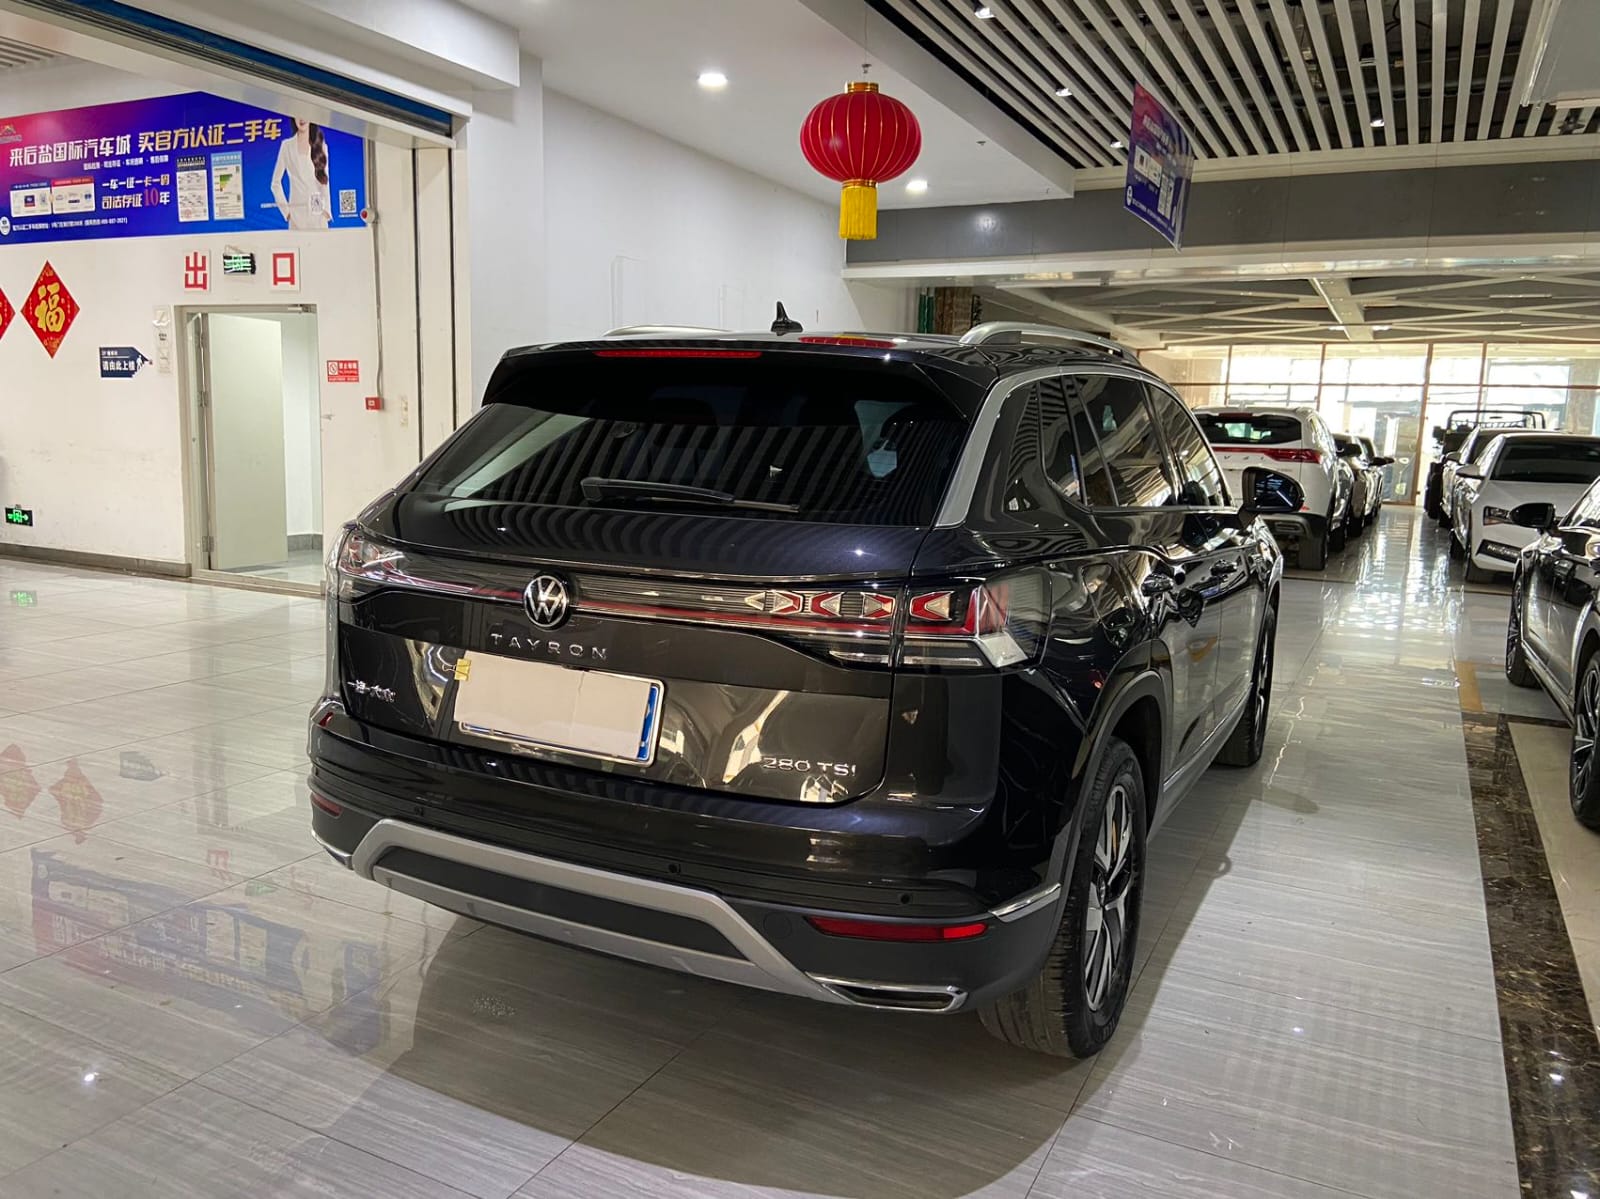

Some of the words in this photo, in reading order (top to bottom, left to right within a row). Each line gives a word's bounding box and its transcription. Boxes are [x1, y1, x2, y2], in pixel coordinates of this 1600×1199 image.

[9, 134, 132, 167] 来后盐国际汽车城
[138, 118, 283, 154] 买官方认证二手车
[34, 282, 65, 332] 福
[489, 632, 608, 661] TAYRON
[760, 757, 811, 772] 280
[816, 762, 857, 777] TSI
